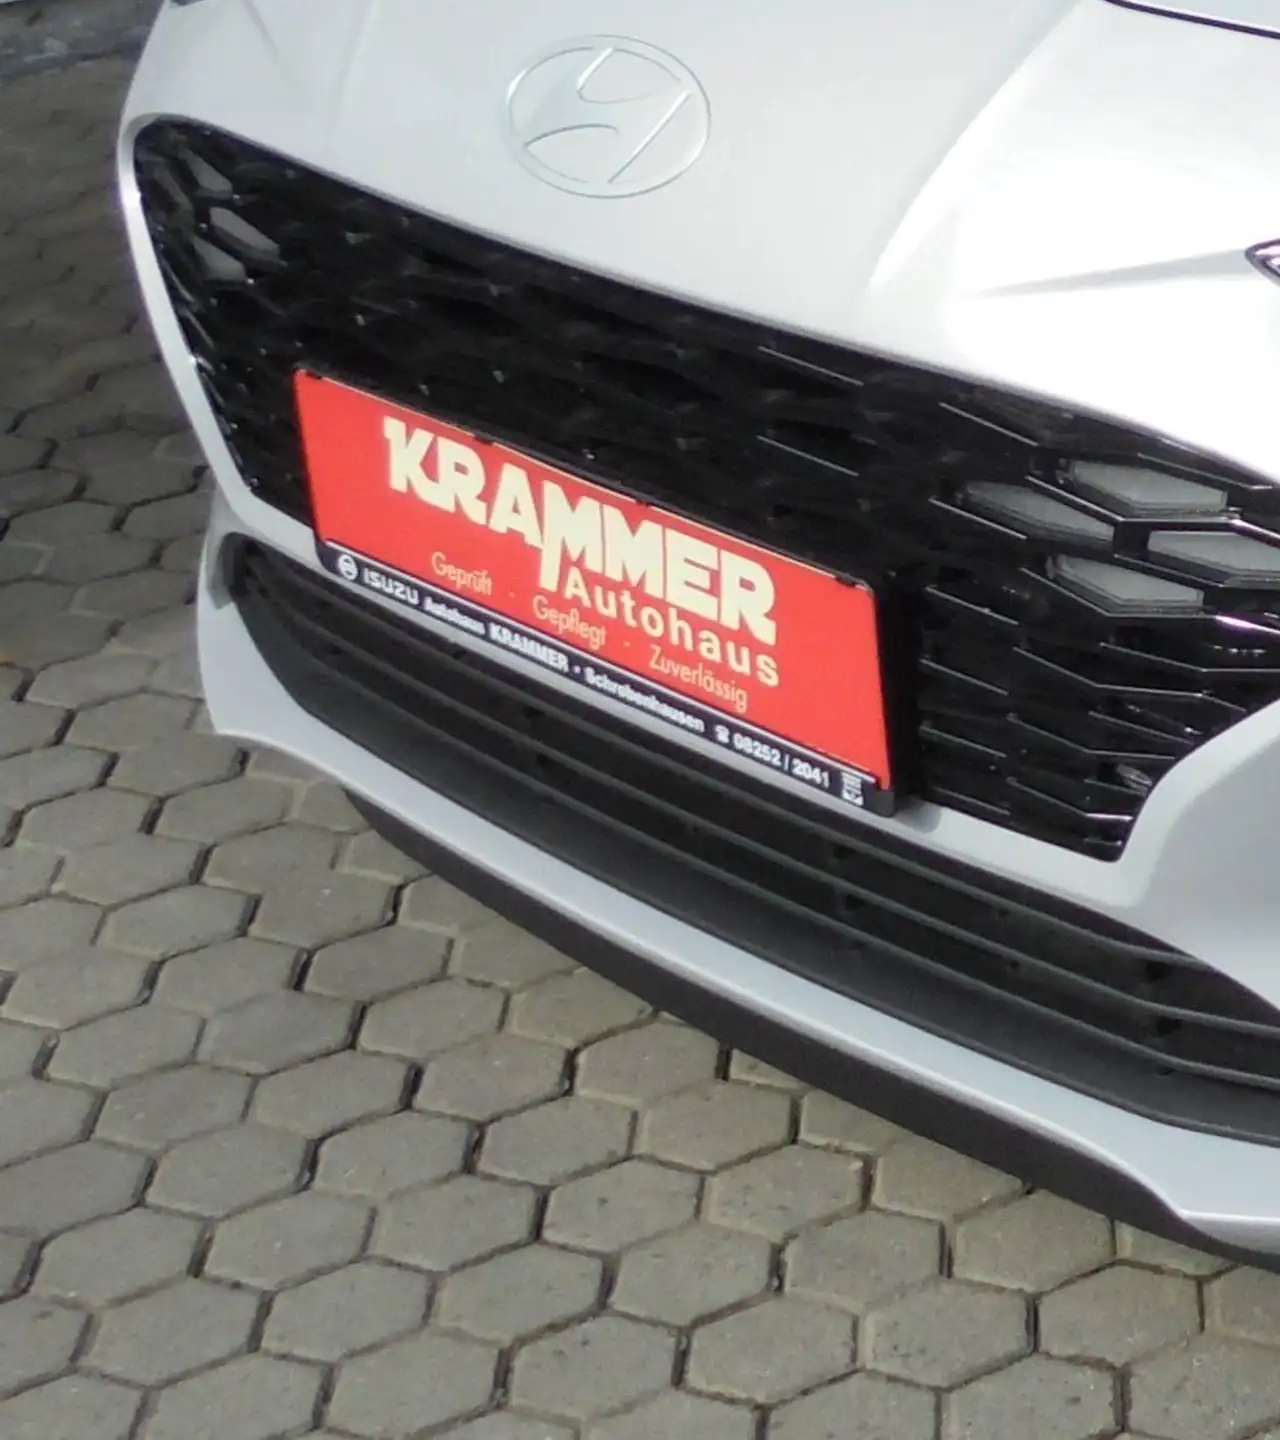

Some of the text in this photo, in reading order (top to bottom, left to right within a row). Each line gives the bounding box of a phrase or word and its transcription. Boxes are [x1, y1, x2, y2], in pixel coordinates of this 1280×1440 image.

[383, 415, 777, 645] KRAMMER
[363, 567, 420, 605] ISUZU
[488, 622, 570, 673] KRAMMER
[732, 732, 782, 767] 08252
[791, 757, 830, 788] 2041
[431, 552, 749, 714] Geprüft Gepflegt Zuverlässig
[564, 566, 780, 687] Autohaus
